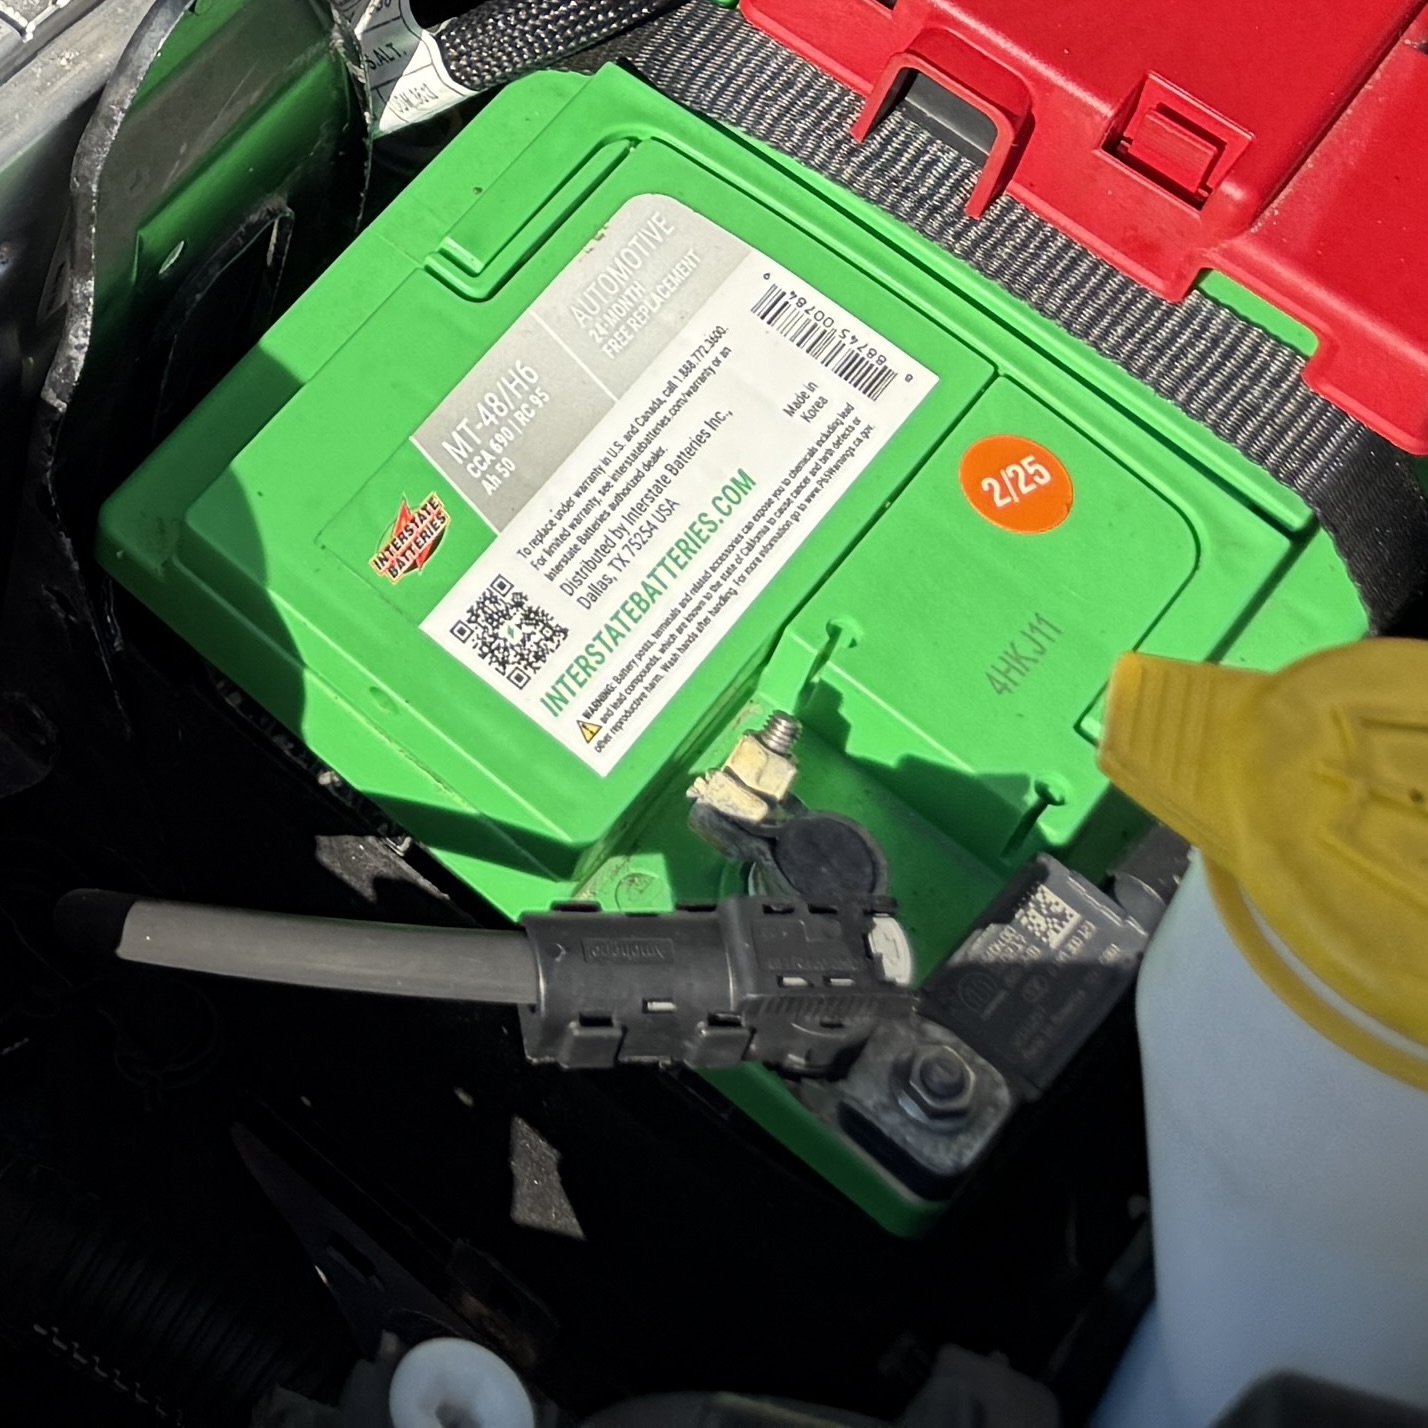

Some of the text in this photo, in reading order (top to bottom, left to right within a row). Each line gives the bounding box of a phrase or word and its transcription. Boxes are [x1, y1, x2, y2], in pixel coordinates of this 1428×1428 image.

[568, 211, 675, 327] AUTOMOTIVE
[587, 281, 646, 343] 24-MONTH
[601, 246, 704, 360] FREE REPLACEMENT
[783, 288, 837, 329] 00784
[782, 381, 818, 417] Made in
[835, 326, 890, 367] 88745
[440, 357, 539, 466] MT-48/H6
[466, 449, 496, 478] CCA
[487, 426, 514, 454] 690
[513, 402, 535, 426] RC
[528, 386, 549, 408] 95
[530, 346, 731, 570] For limited warranty, see interstatebatteries.com/warranty or an
[799, 395, 828, 423] Korea
[479, 455, 517, 497] Ah 50
[516, 547, 531, 558] To
[528, 519, 556, 548] replace
[551, 496, 575, 520] under
[573, 464, 605, 497] warranty
[599, 456, 612, 466] in
[606, 440, 625, 457] U.S.
[623, 423, 639, 442] and
[634, 397, 666, 426] Canada,
[662, 380, 678, 397] call
[544, 446, 667, 581] Interstate Batteries authorized dealer.
[559, 410, 732, 596] Distributed by Interstate Batteries Inc.,
[981, 454, 1052, 508] 2/25
[371, 495, 440, 572] INTERSTATE
[385, 508, 449, 580] BATTERIES
[576, 498, 679, 609] Dallas, TX 75254 USA
[582, 401, 854, 719] WARNING: Battery posts, terminals and related accessories can expose you to chemicals including lead
[599, 416, 861, 724] and lead compounds, which are known to the state of California to cause cancer and birth defects or
[541, 469, 754, 715] INTERSTATEBATTERIES.COM
[594, 732, 612, 753] other
[609, 691, 647, 734] reproductive
[659, 652, 680, 672] Wash
[675, 631, 698, 653] hands
[695, 615, 711, 633] after
[732, 573, 746, 586] For
[744, 556, 762, 575] more
[758, 519, 793, 557] information
[789, 510, 801, 522] go
[796, 502, 807, 511] to
[984, 611, 1064, 696] 4HKJ11
